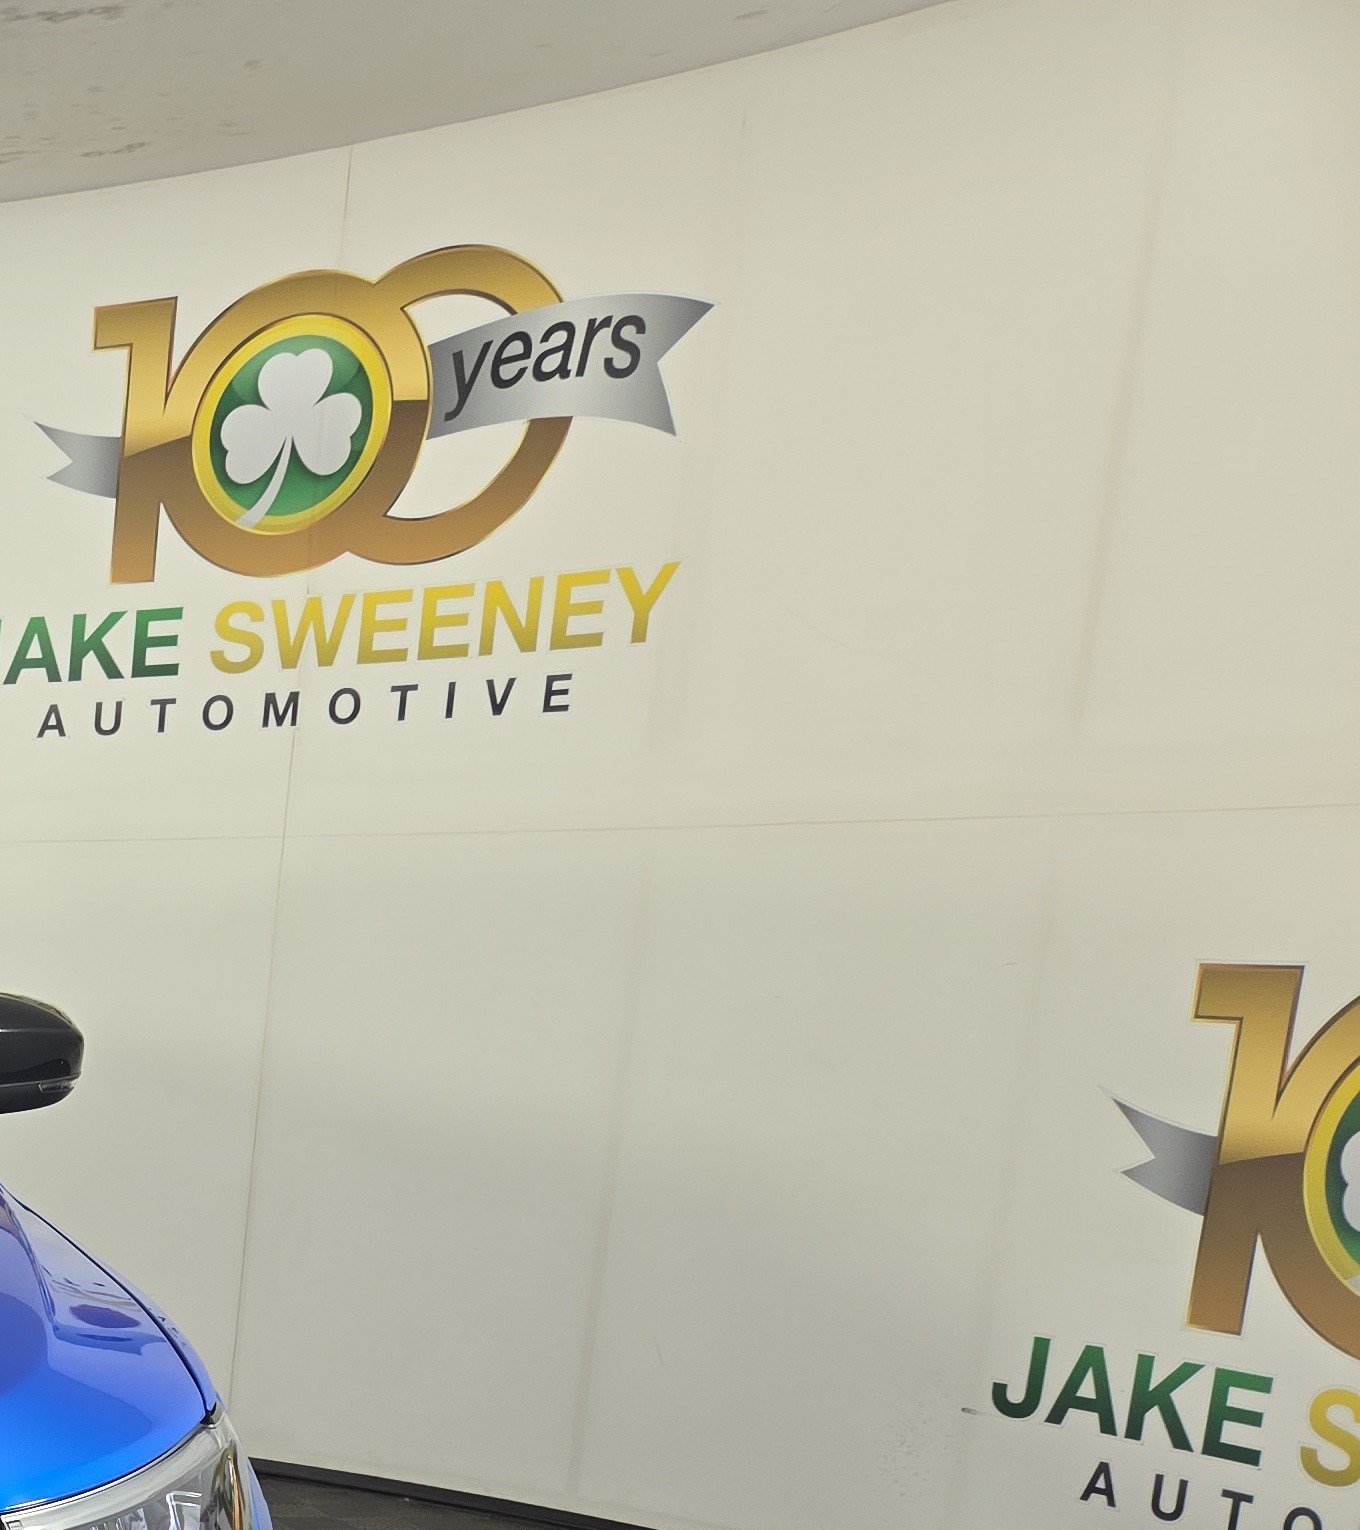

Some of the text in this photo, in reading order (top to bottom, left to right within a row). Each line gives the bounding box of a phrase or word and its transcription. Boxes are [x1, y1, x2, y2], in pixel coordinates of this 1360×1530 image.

[93, 244, 647, 585] 100 years
[210, 561, 682, 675] SWEENEY
[37, 673, 574, 739] AUTOMOTIVE
[991, 1336, 1274, 1467] JAKE
